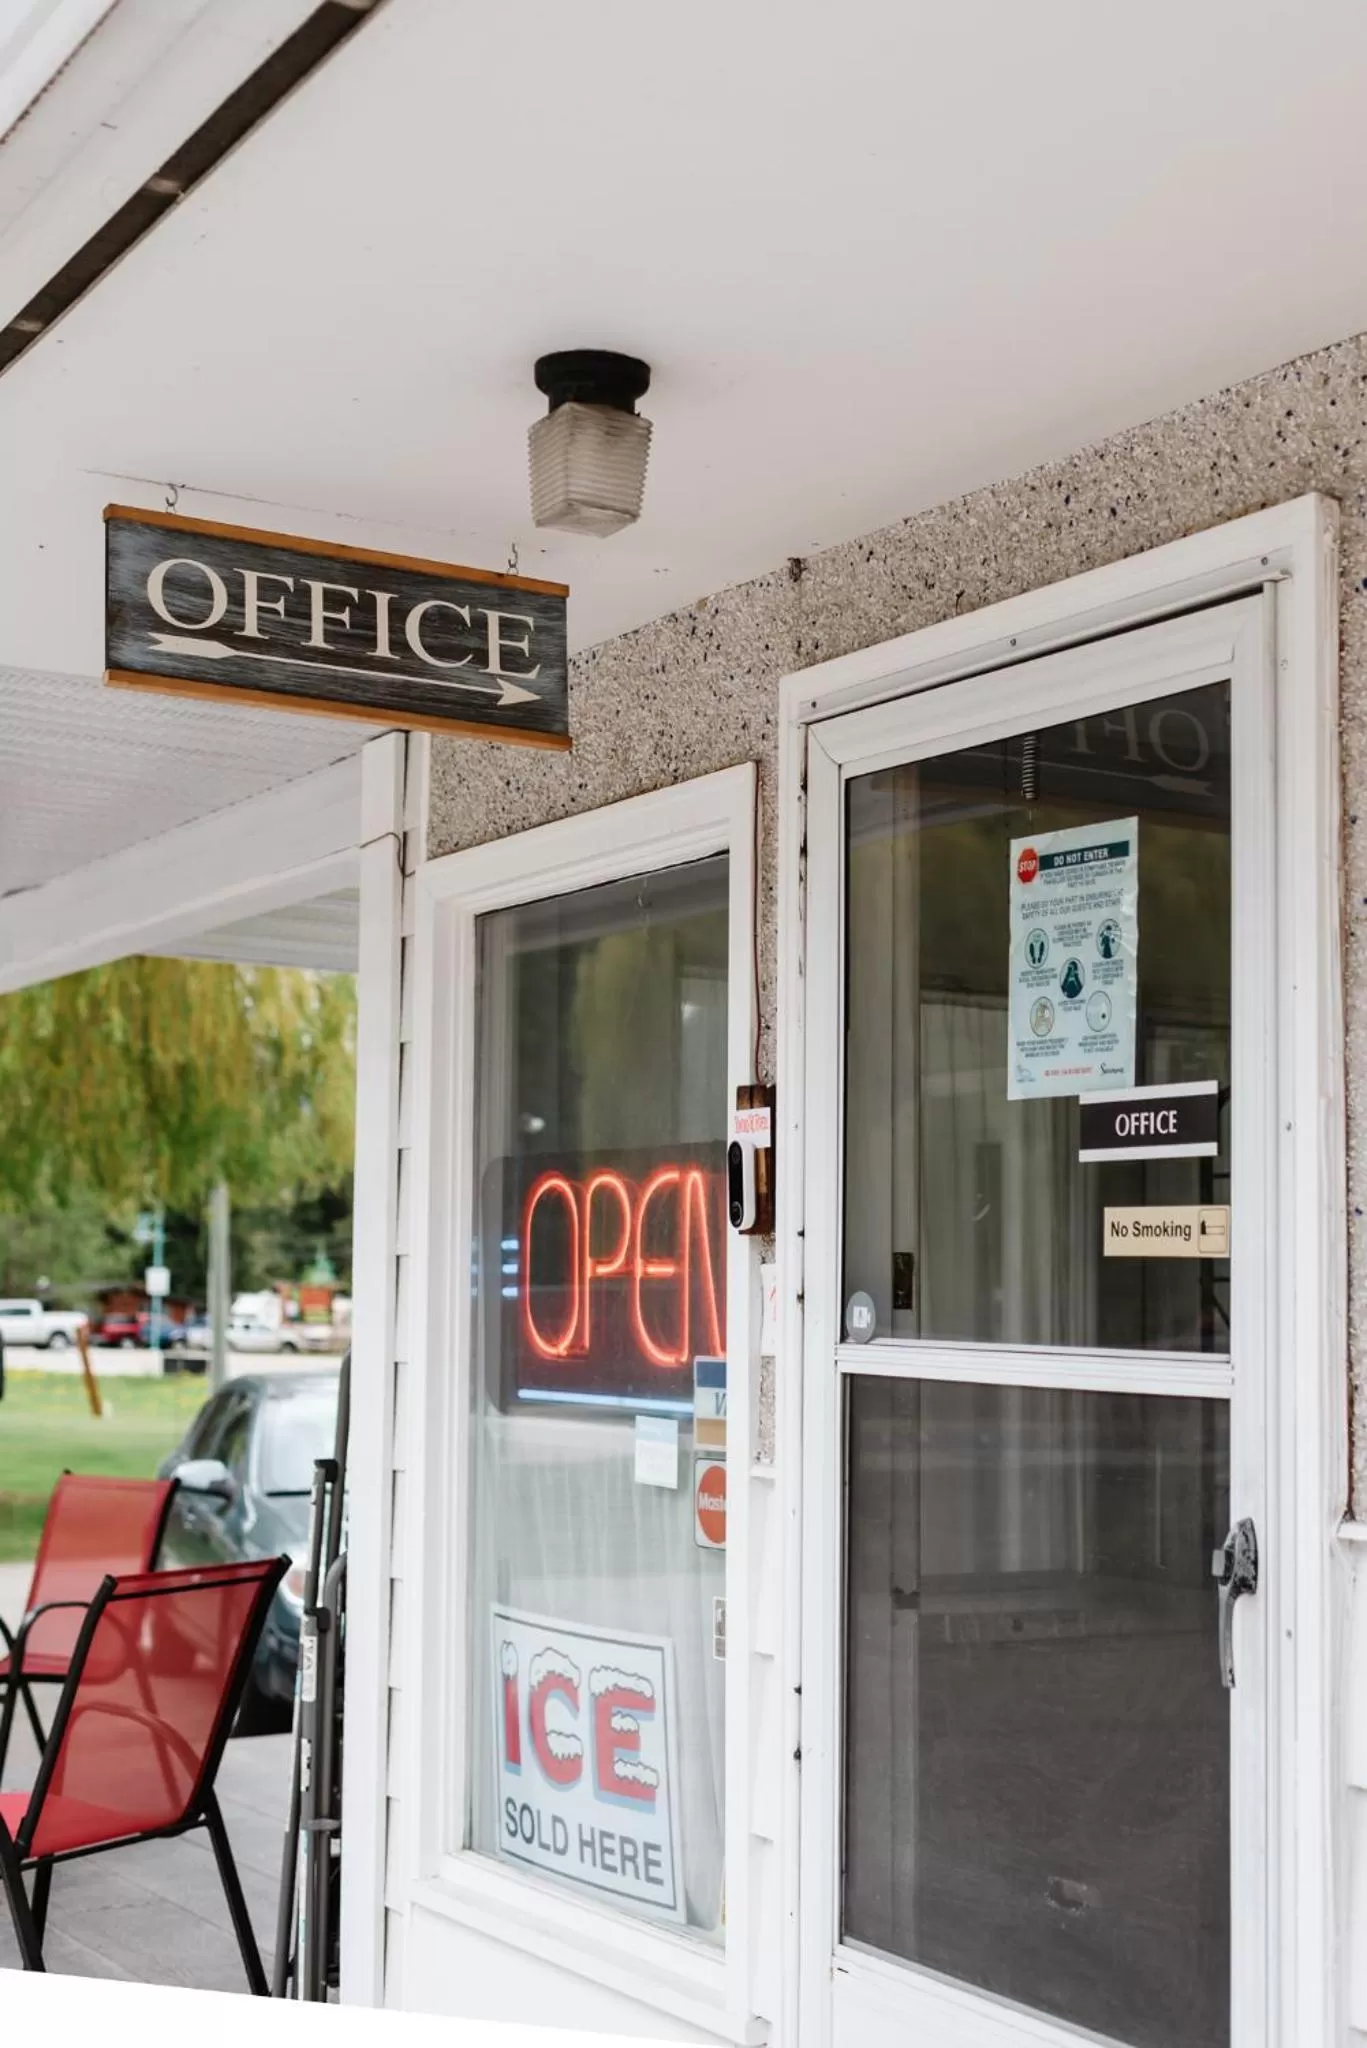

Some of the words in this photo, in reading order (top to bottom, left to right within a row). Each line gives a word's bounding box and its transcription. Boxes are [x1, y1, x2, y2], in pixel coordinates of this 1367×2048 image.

[146, 557, 542, 680] OFFICE
[1019, 860, 1037, 873] STOP
[1053, 854, 1064, 867] DO
[1066, 852, 1081, 865] NOT
[1083, 848, 1110, 861] ENTER
[1114, 1109, 1178, 1137] OFFICE
[1110, 1221, 1129, 1238] No
[1132, 1220, 1192, 1242] Smoking
[500, 1639, 660, 1814] ICE
[504, 1796, 569, 1857] SOLD
[577, 1822, 664, 1887] HERE
